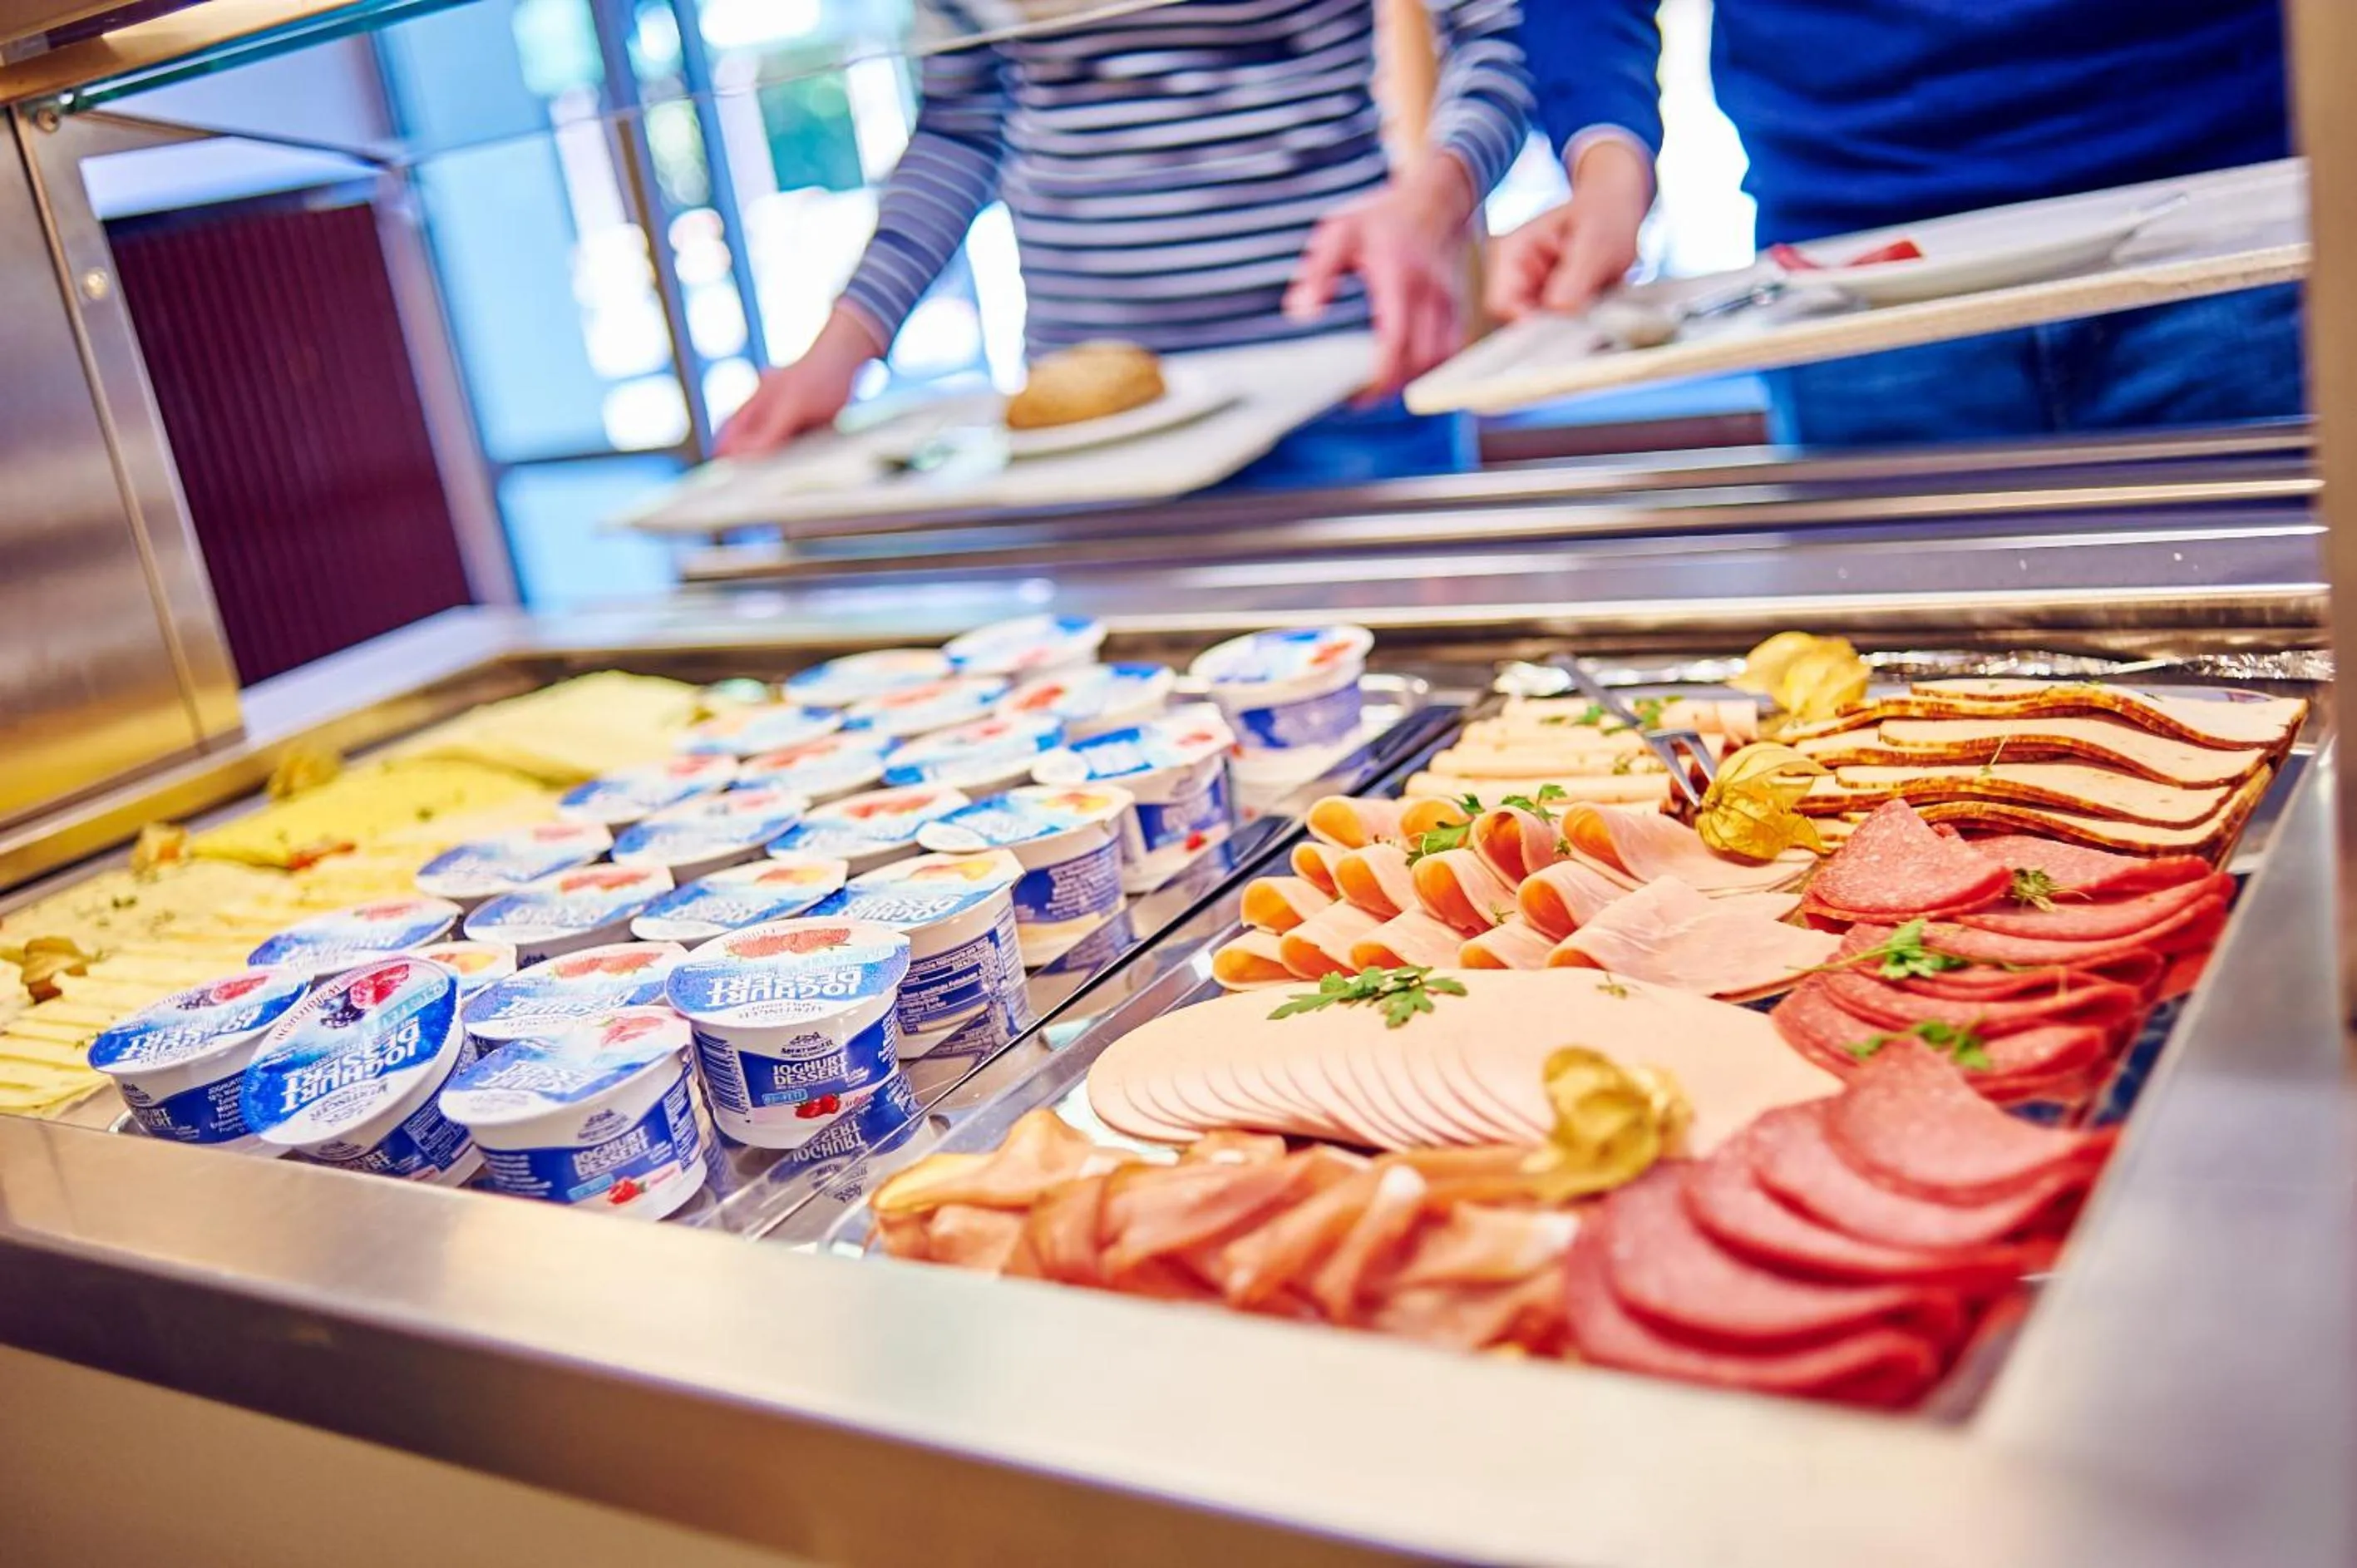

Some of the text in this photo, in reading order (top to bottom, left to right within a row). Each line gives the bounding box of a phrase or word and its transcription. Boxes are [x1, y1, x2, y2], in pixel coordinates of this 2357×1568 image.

[704, 981, 860, 1007] JOGHURT
[705, 966, 862, 995] DESSERT
[282, 1017, 421, 1096] DESSERT
[772, 1051, 848, 1076] JOGHURT
[774, 1062, 849, 1086] DESSERT
[279, 1038, 417, 1113] JOGHURT
[572, 1125, 648, 1166] JOGHURT
[575, 1137, 650, 1178] DESSERT
